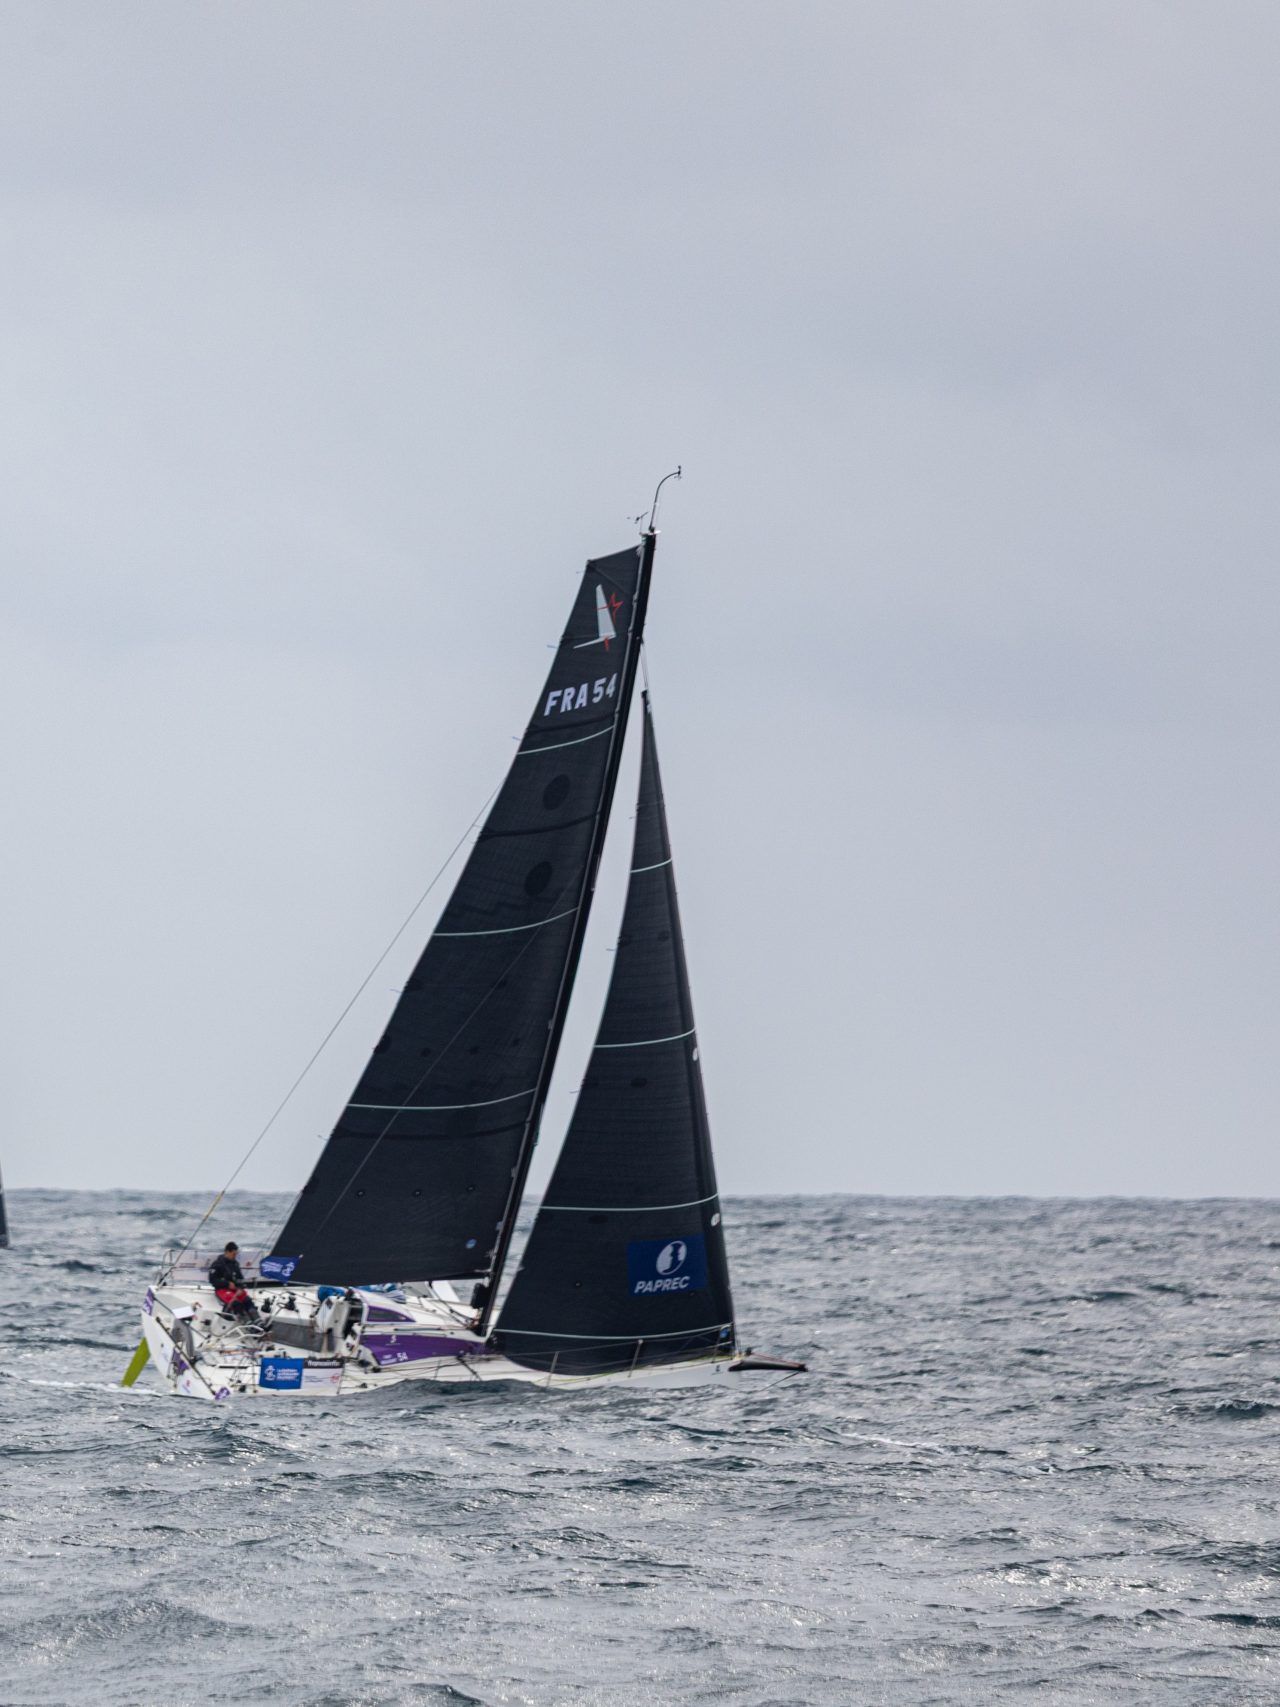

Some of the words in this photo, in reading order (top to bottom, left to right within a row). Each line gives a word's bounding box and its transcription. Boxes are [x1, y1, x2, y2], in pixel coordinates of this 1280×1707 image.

[543, 683, 589, 716] FRA
[592, 672, 619, 703] 54
[634, 1275, 691, 1294] PAPREC
